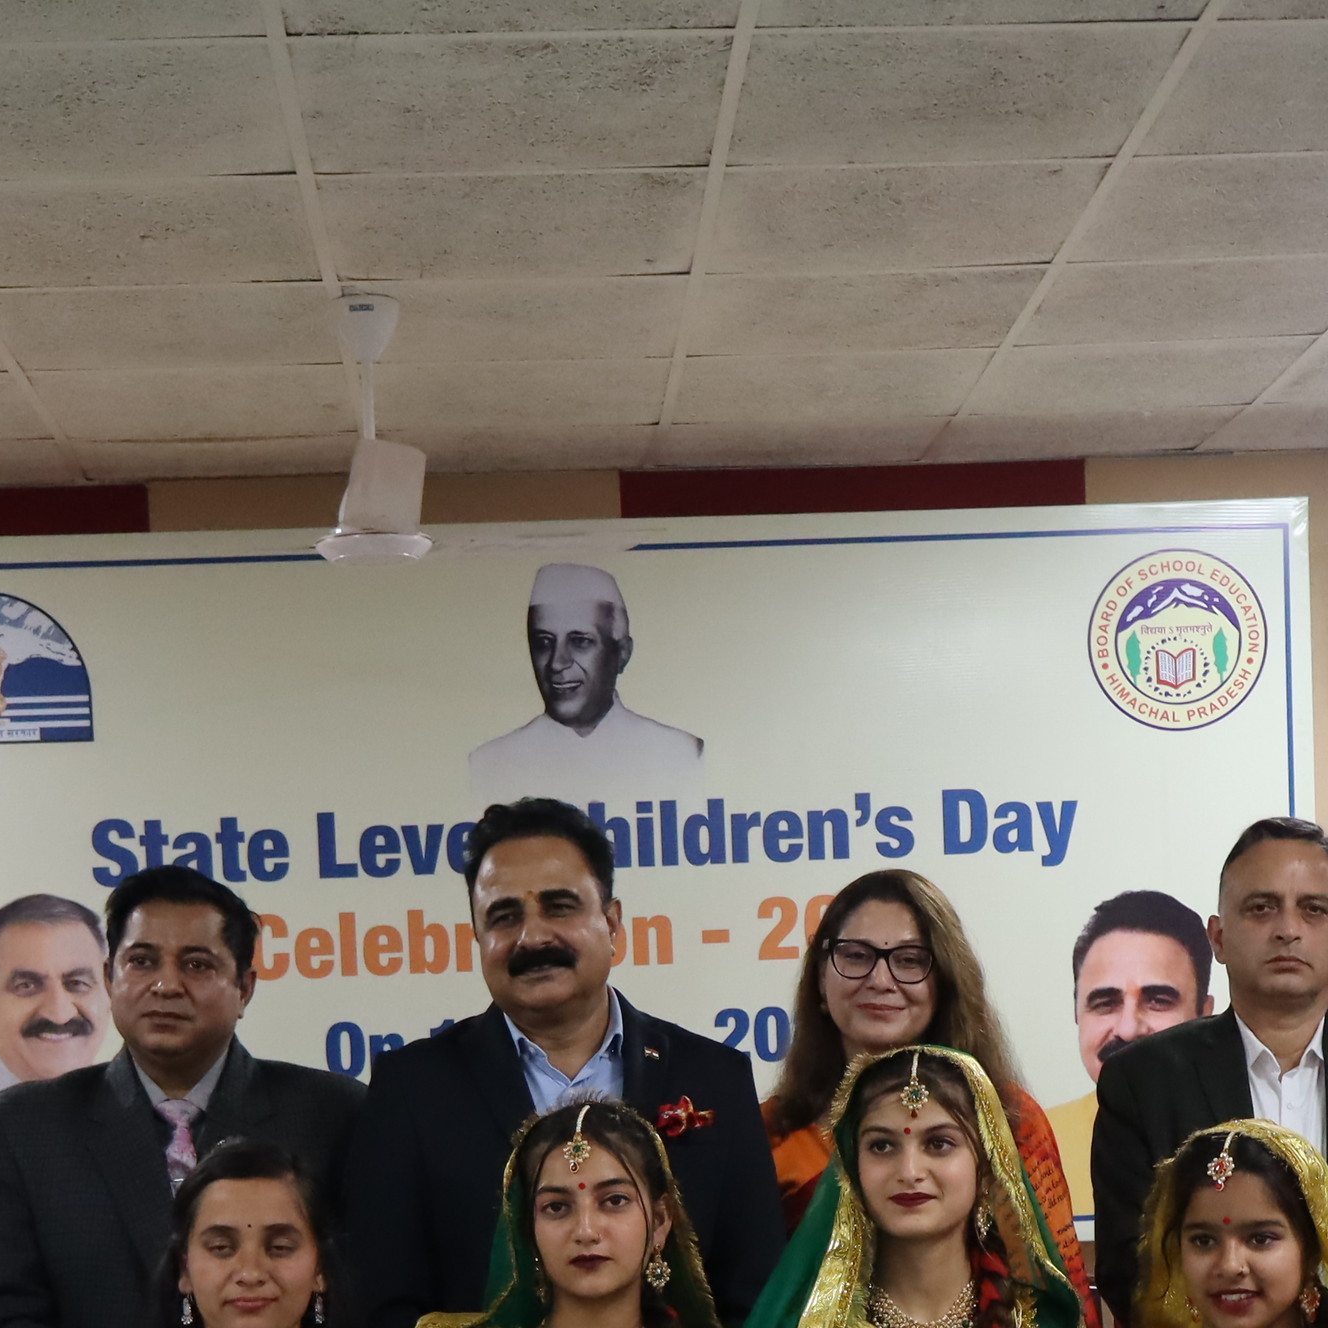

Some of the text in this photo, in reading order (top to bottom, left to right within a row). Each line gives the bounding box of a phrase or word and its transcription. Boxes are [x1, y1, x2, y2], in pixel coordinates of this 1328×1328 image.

[1097, 560, 1260, 658] BOARD OF SCHOOL EDUCATION
[1106, 668, 1252, 722] HIMACHAL PRADESH
[91, 788, 1078, 887] State Leve hildren's Day
